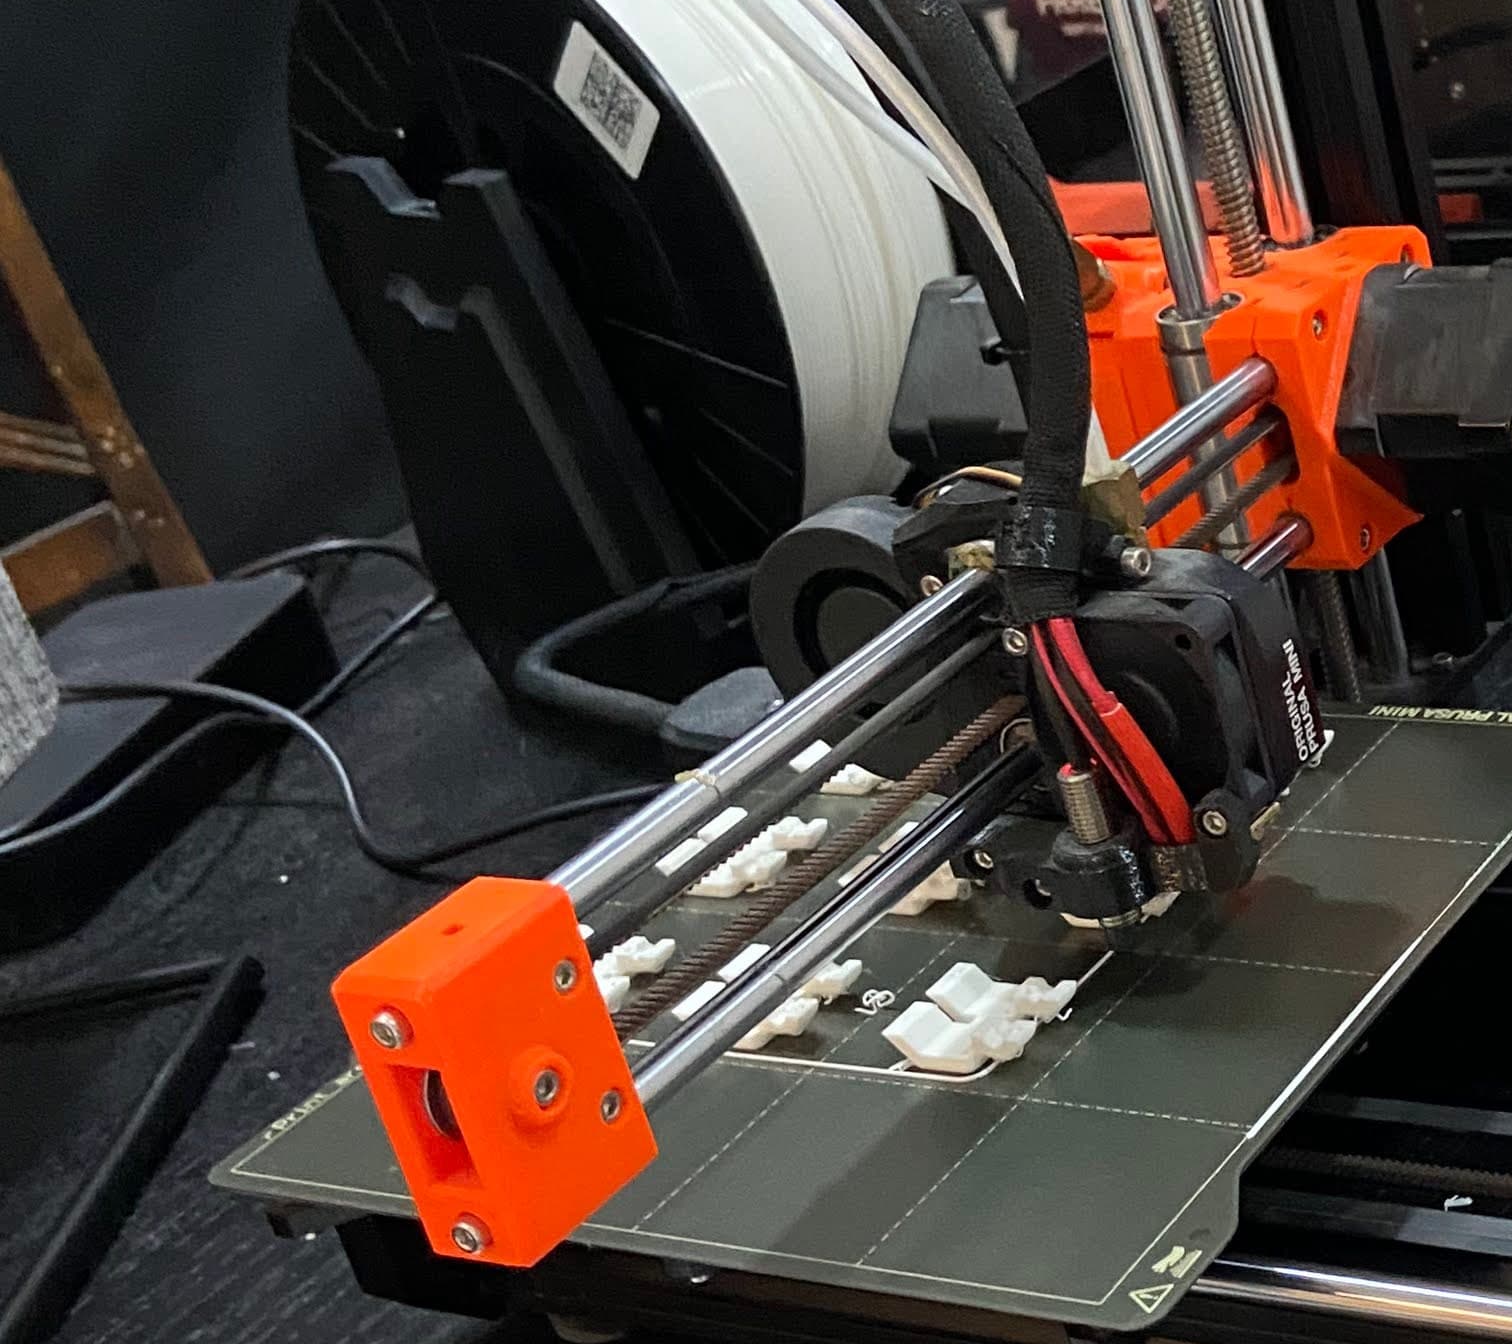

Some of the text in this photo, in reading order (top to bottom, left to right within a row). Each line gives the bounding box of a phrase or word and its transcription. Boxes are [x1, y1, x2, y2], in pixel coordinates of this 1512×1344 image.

[1281, 638, 1320, 754] PRUSA MINI
[1282, 671, 1309, 762] ORIGINAL
[1368, 705, 1422, 718] MINI
[1423, 706, 1495, 722] PRUSA
